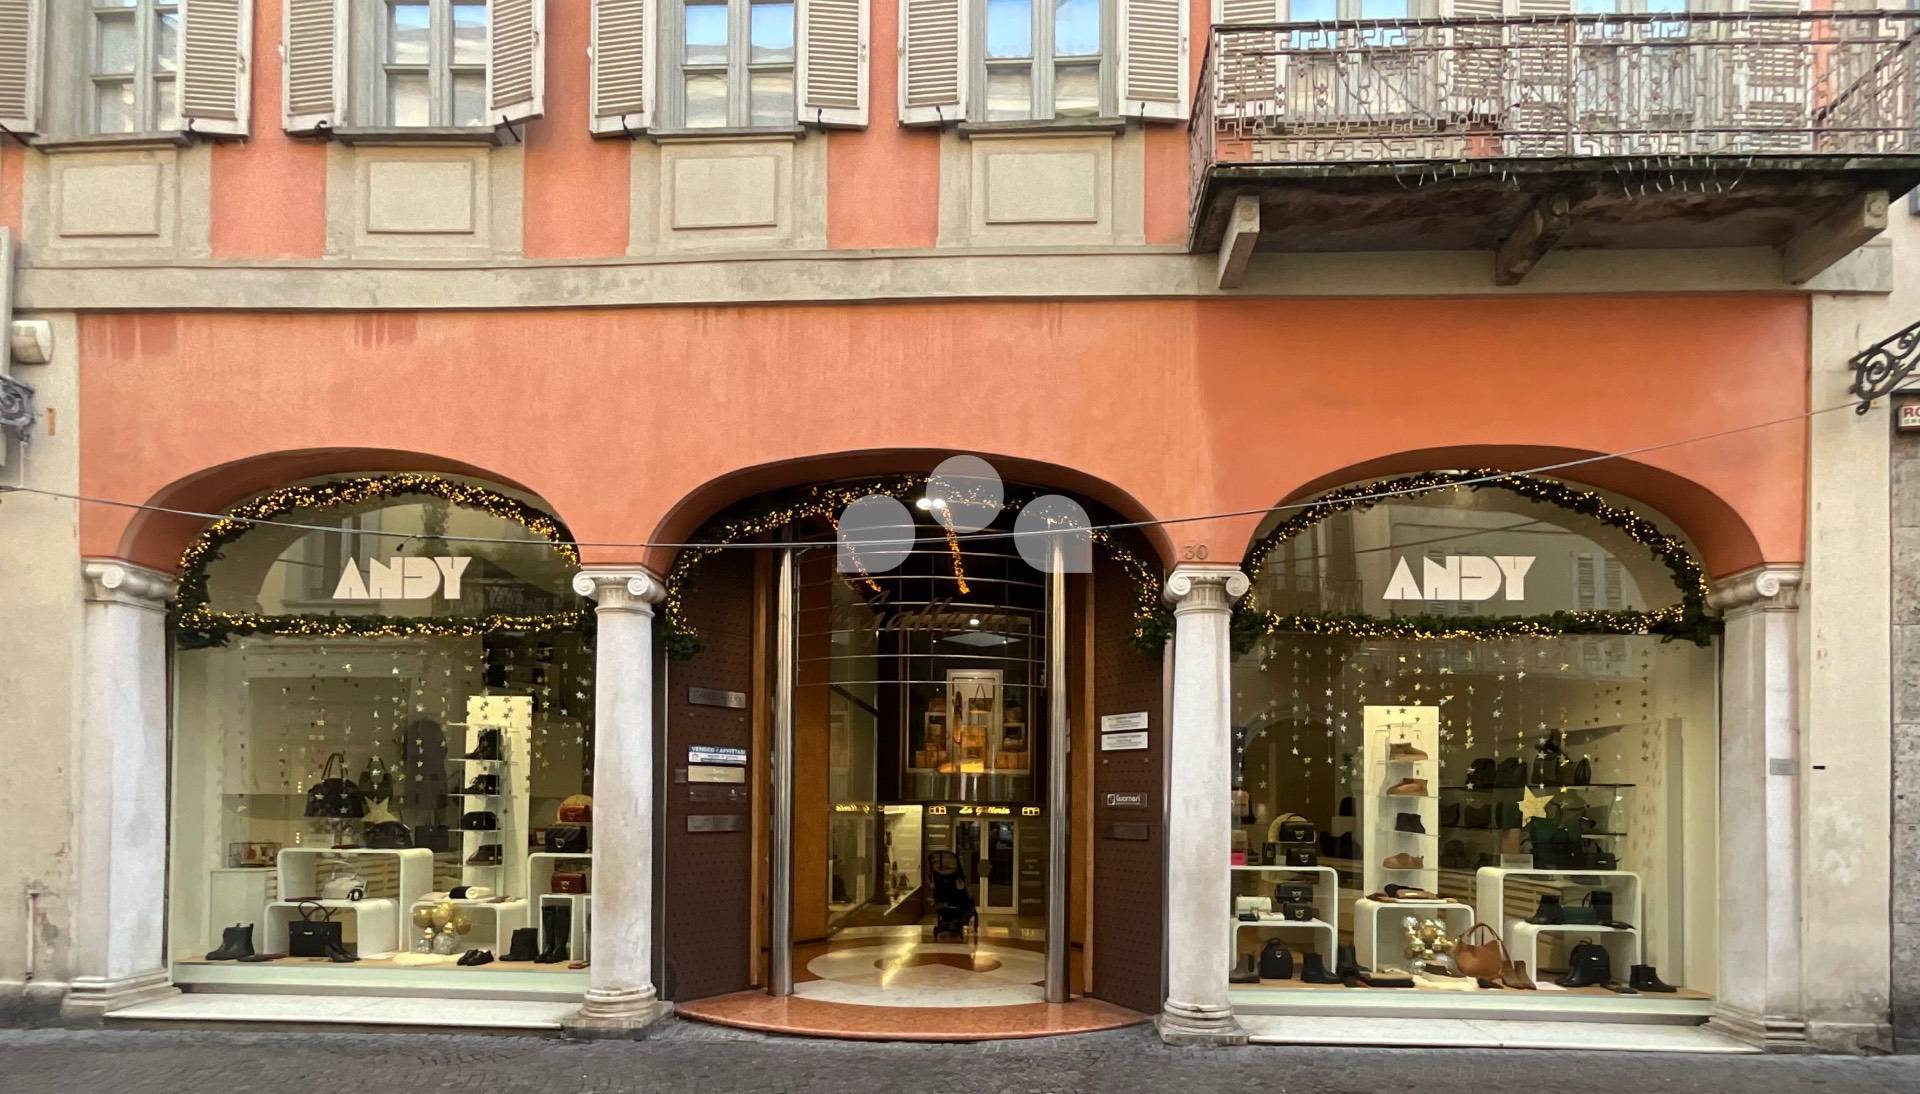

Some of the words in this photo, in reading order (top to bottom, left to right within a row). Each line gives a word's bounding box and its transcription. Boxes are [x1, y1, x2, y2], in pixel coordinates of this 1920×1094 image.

[1184, 544, 1210, 560] 30
[332, 556, 472, 599] ANDY
[1382, 555, 1536, 600] ANDY
